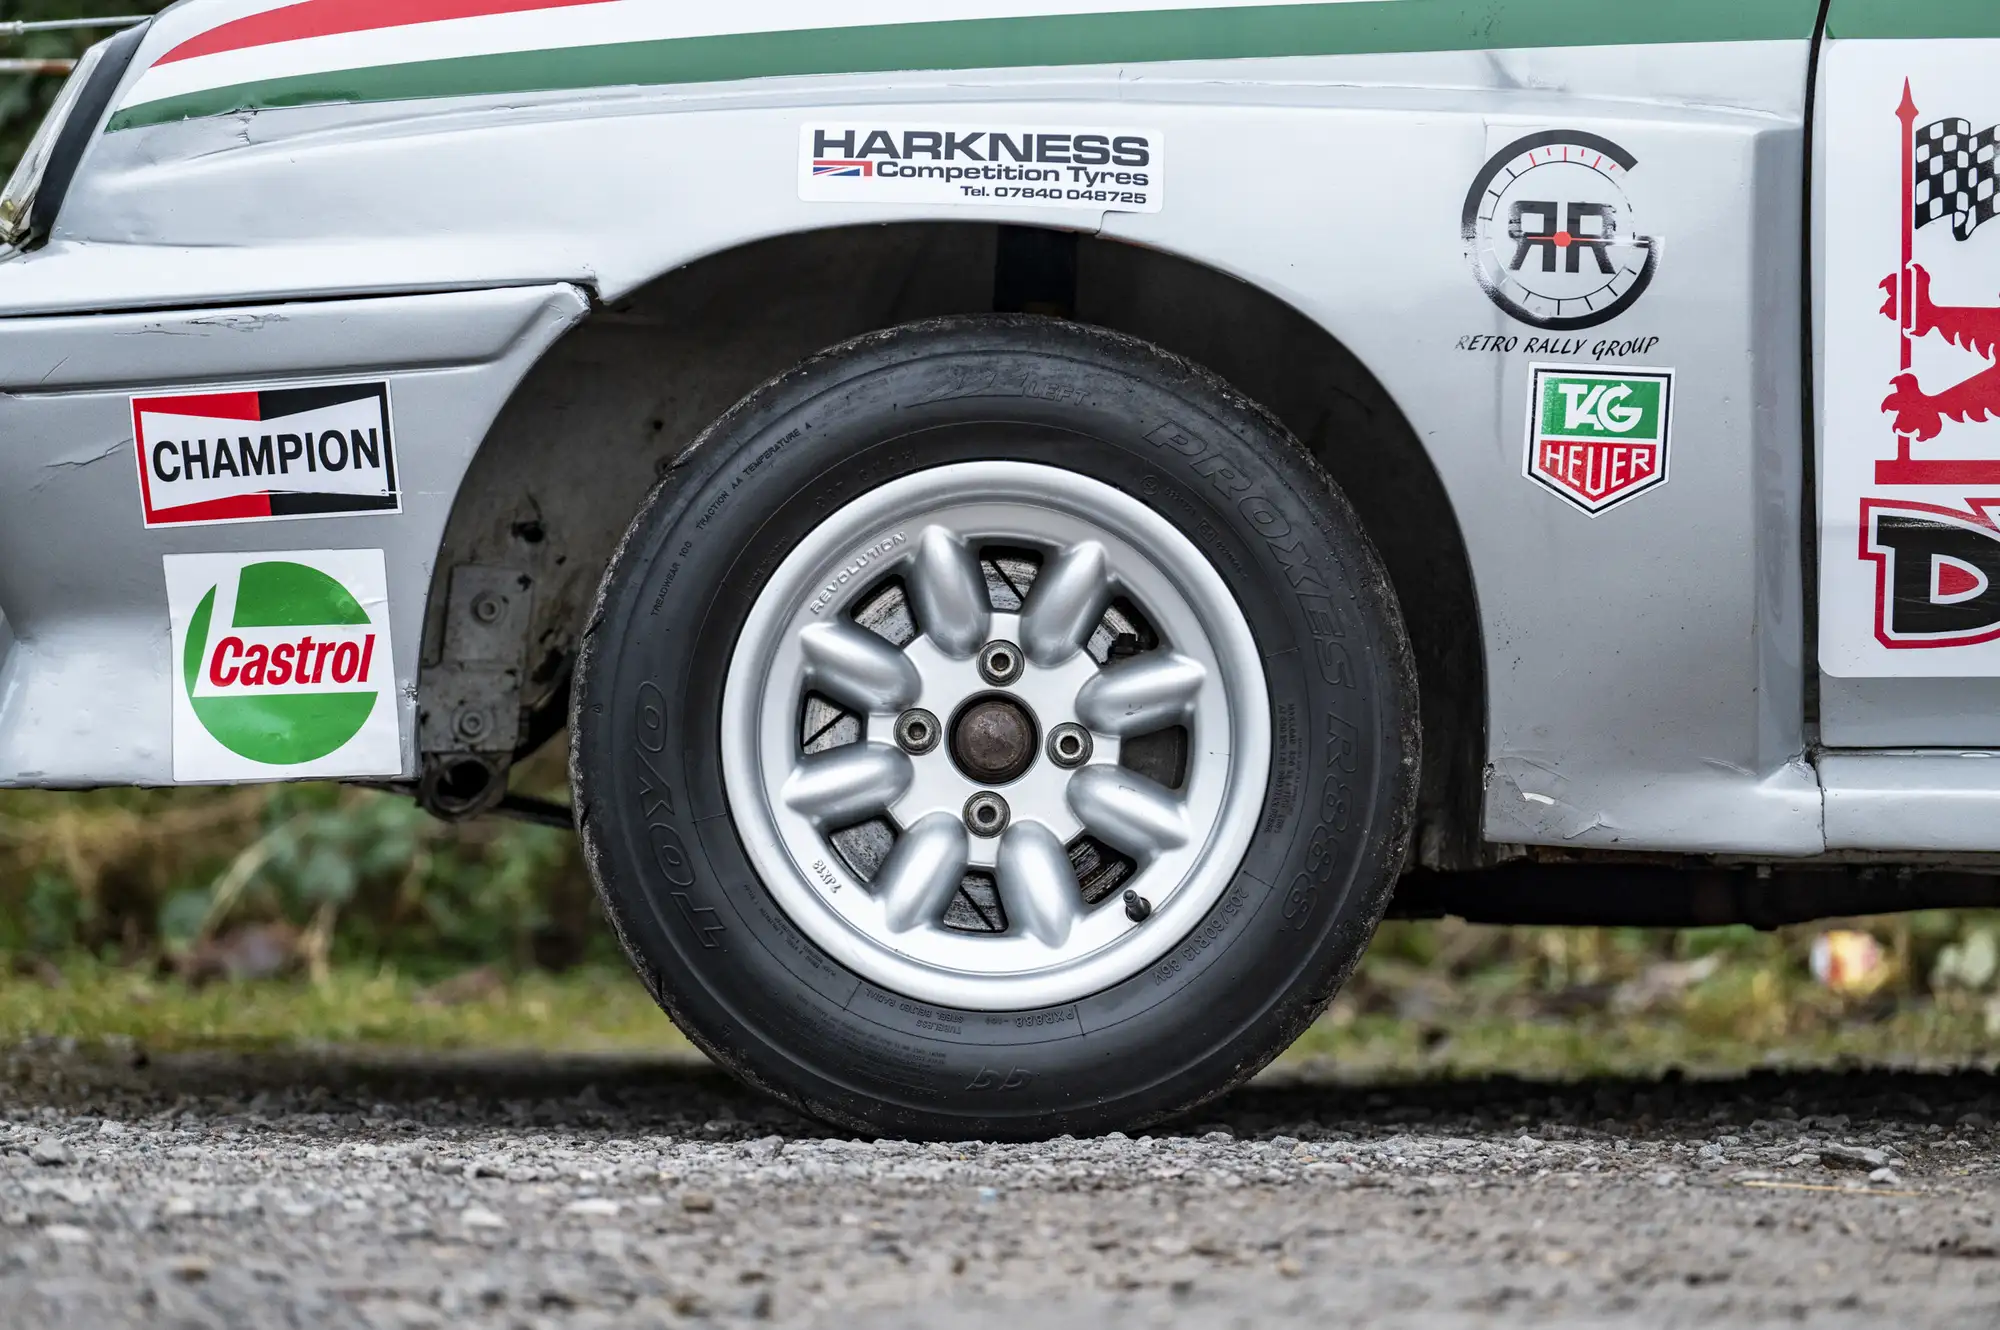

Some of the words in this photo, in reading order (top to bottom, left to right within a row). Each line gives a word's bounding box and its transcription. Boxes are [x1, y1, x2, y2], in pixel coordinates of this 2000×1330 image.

[812, 129, 1150, 167] HARKNESS
[877, 161, 1060, 183] Competition
[1066, 165, 1150, 187] Tyres
[960, 185, 990, 198] Tel.
[994, 187, 1063, 200] 07840
[1066, 189, 1147, 204] 048725
[1455, 334, 1519, 353] RETRO
[1523, 336, 1588, 356] RALLY
[1592, 336, 1660, 360] GROUP
[1558, 382, 1643, 432] TAG
[151, 427, 382, 483] CHAMPION
[1546, 445, 1650, 497] HEUER
[651, 562, 680, 616] TREADWEAR
[679, 541, 692, 558] 100
[696, 490, 730, 530] TRACTION
[731, 477, 743, 490] AA
[742, 428, 801, 476] TEMPERATURE
[805, 422, 812, 430] A
[810, 531, 908, 615] REVOLUTION
[208, 633, 376, 687] Castrol
[1141, 420, 1356, 690] PROXES
[1282, 711, 1360, 931] R888
[634, 681, 728, 948] TOYO
[1182, 886, 1250, 963] 205/60R13
[1152, 961, 1182, 987] 86V
[935, 1010, 965, 1024] STEEL
[1014, 1013, 1076, 1028] PXR888
